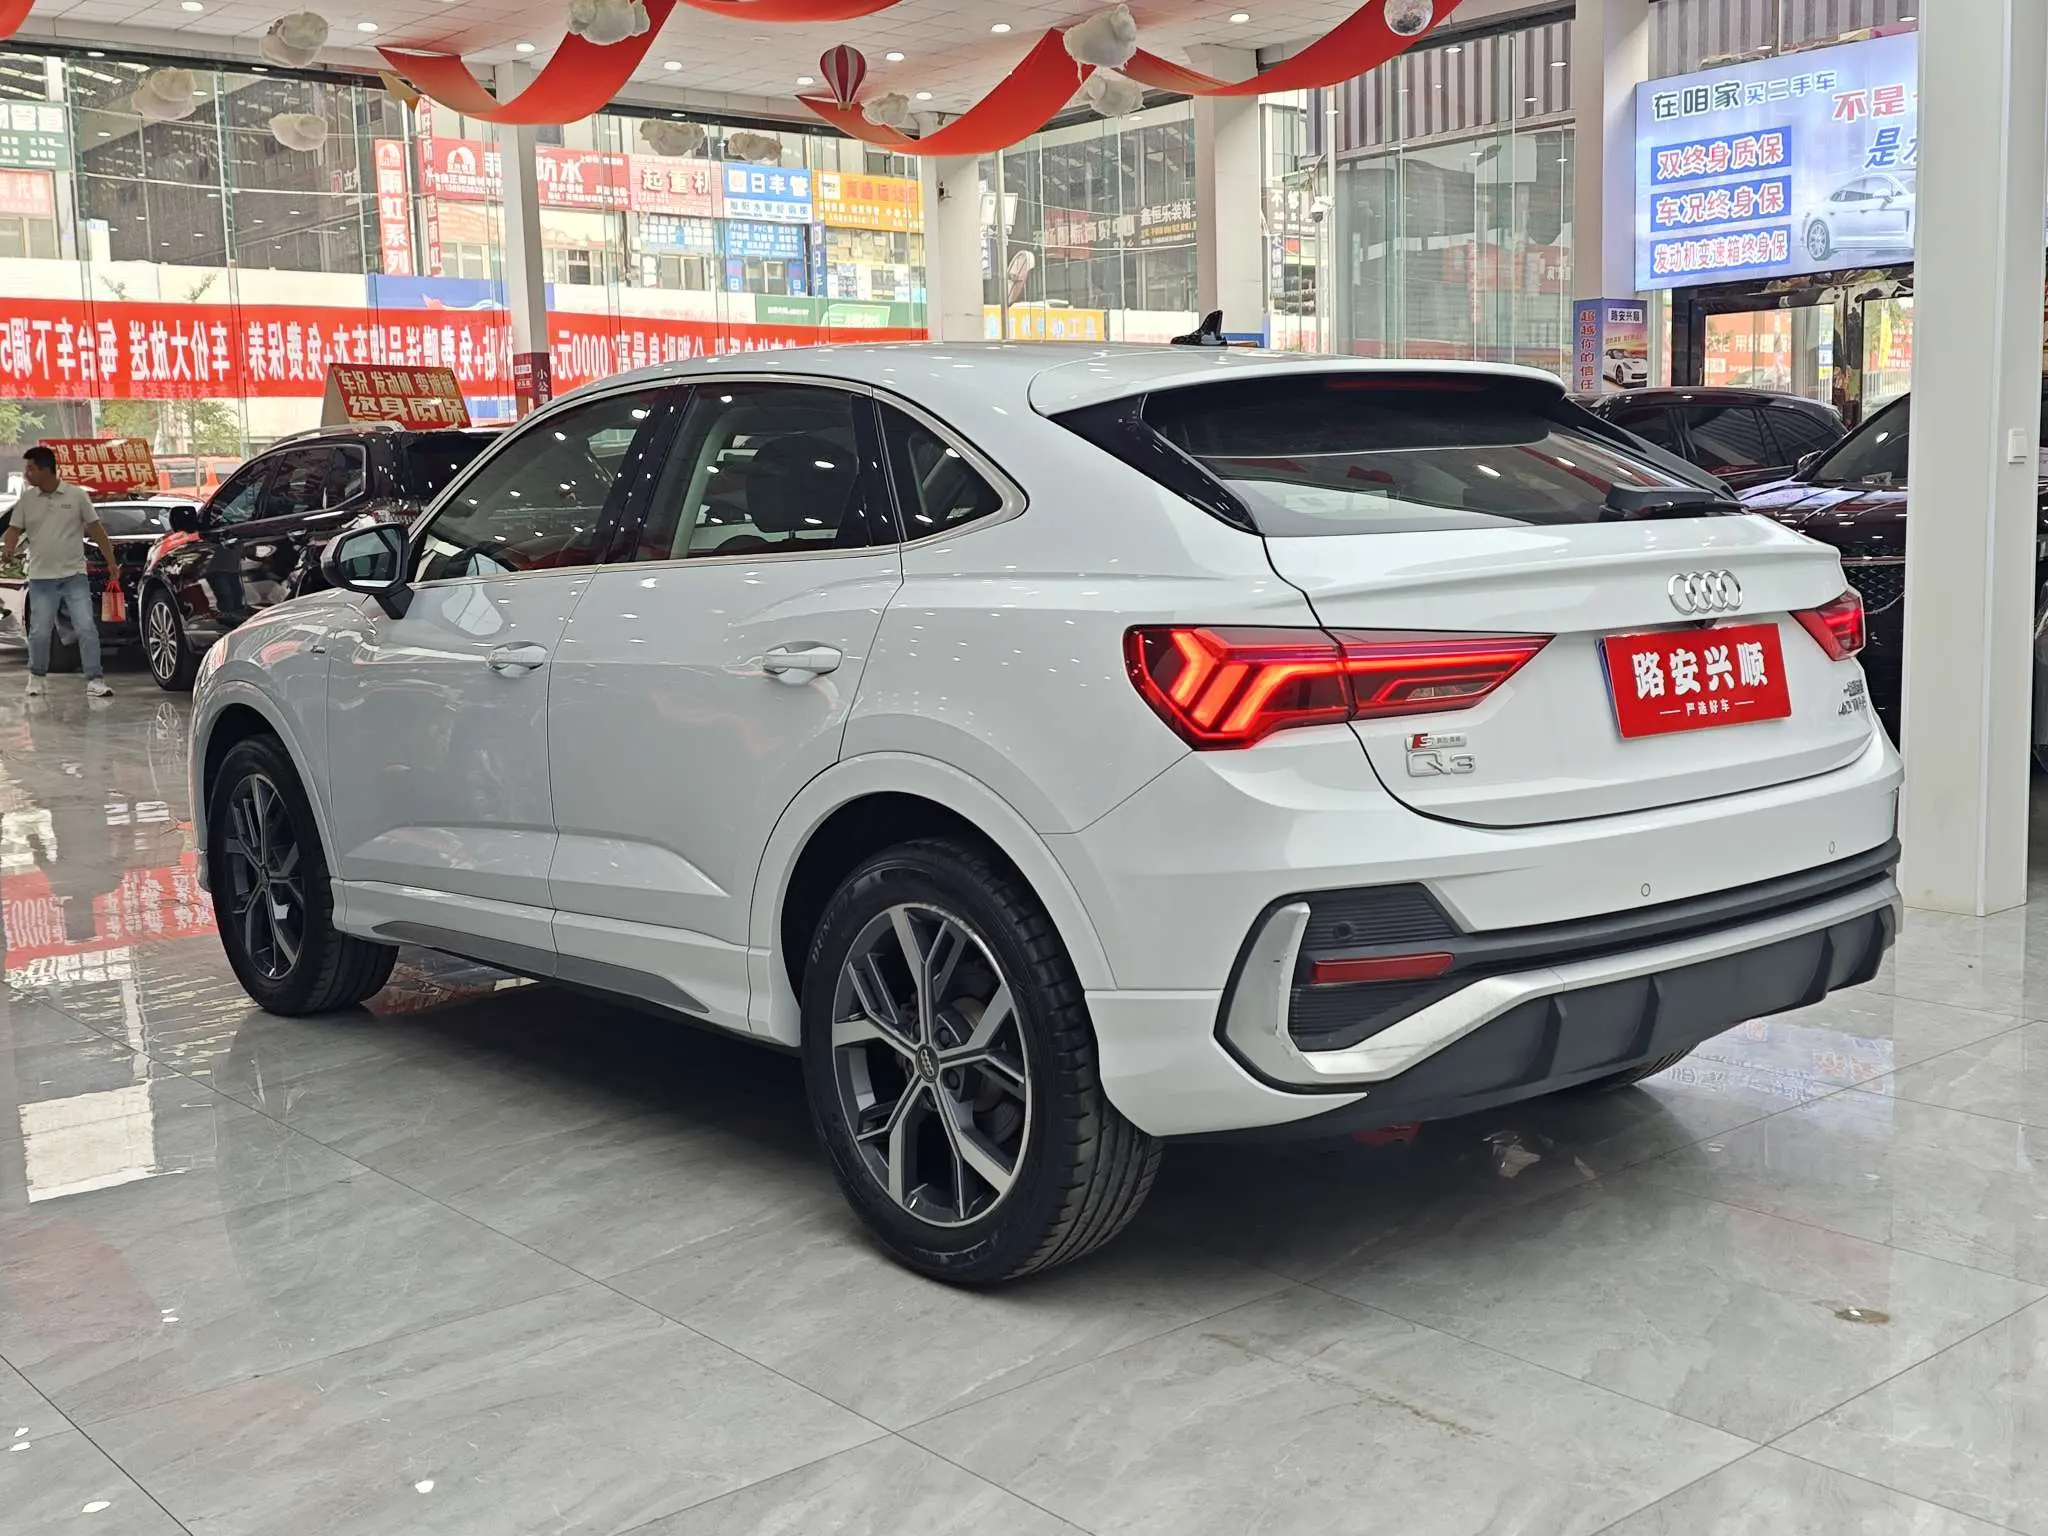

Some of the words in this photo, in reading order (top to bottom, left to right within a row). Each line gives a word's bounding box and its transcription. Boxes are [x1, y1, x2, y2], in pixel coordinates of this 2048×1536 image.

[1832, 84, 1918, 121] 不是
[1658, 134, 1784, 179] 双终身质保
[379, 170, 409, 274] 雨虹系列
[1657, 183, 1784, 227] 车况终身保
[1654, 230, 1788, 273] 发动机变速箱终身保
[1580, 311, 1596, 390] 超越你的信任
[340, 370, 371, 395] 车况
[371, 370, 415, 396] 发动机
[349, 396, 467, 422] 终身质保
[1632, 641, 1768, 699] 路安兴顺
[1685, 699, 1731, 717] 严选好车
[1406, 750, 1477, 778] Q3
